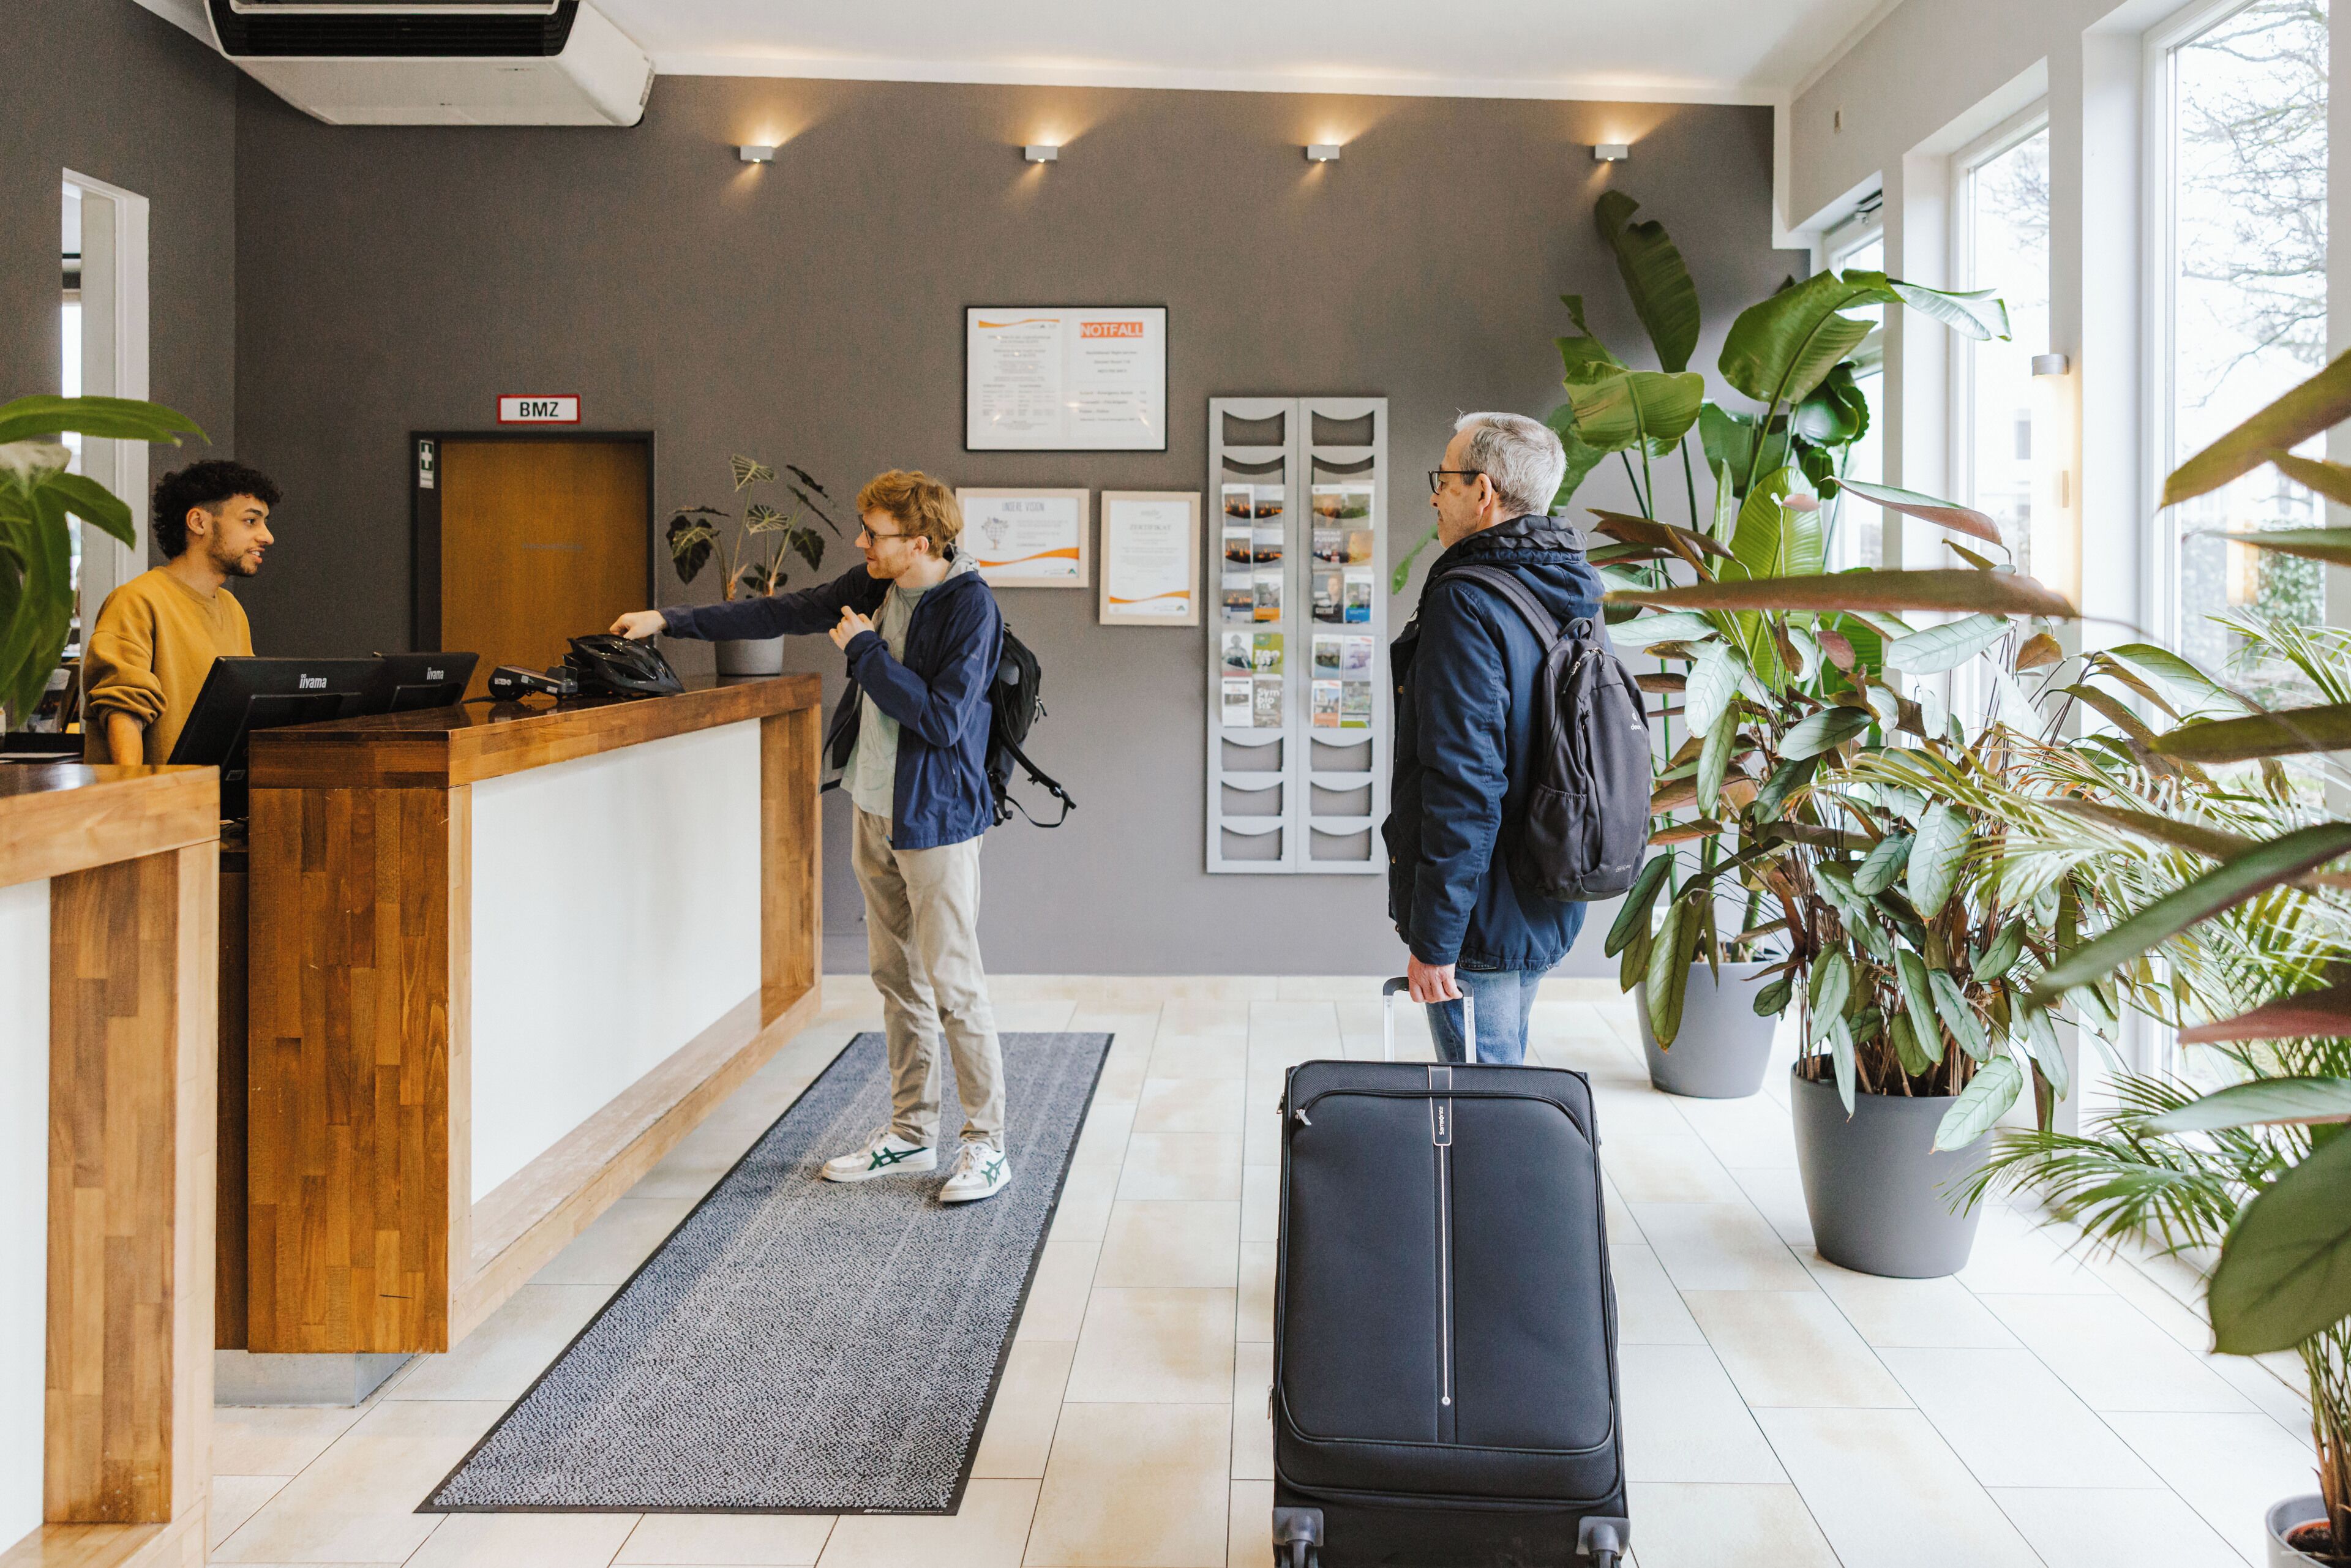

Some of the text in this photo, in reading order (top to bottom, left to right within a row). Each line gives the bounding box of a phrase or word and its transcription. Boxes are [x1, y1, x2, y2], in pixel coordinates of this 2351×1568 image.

[1080, 323, 1143, 337] NOTFALL
[520, 402, 559, 417] BMZ
[427, 667, 444, 680] iiyama
[299, 673, 327, 689] iiyama
